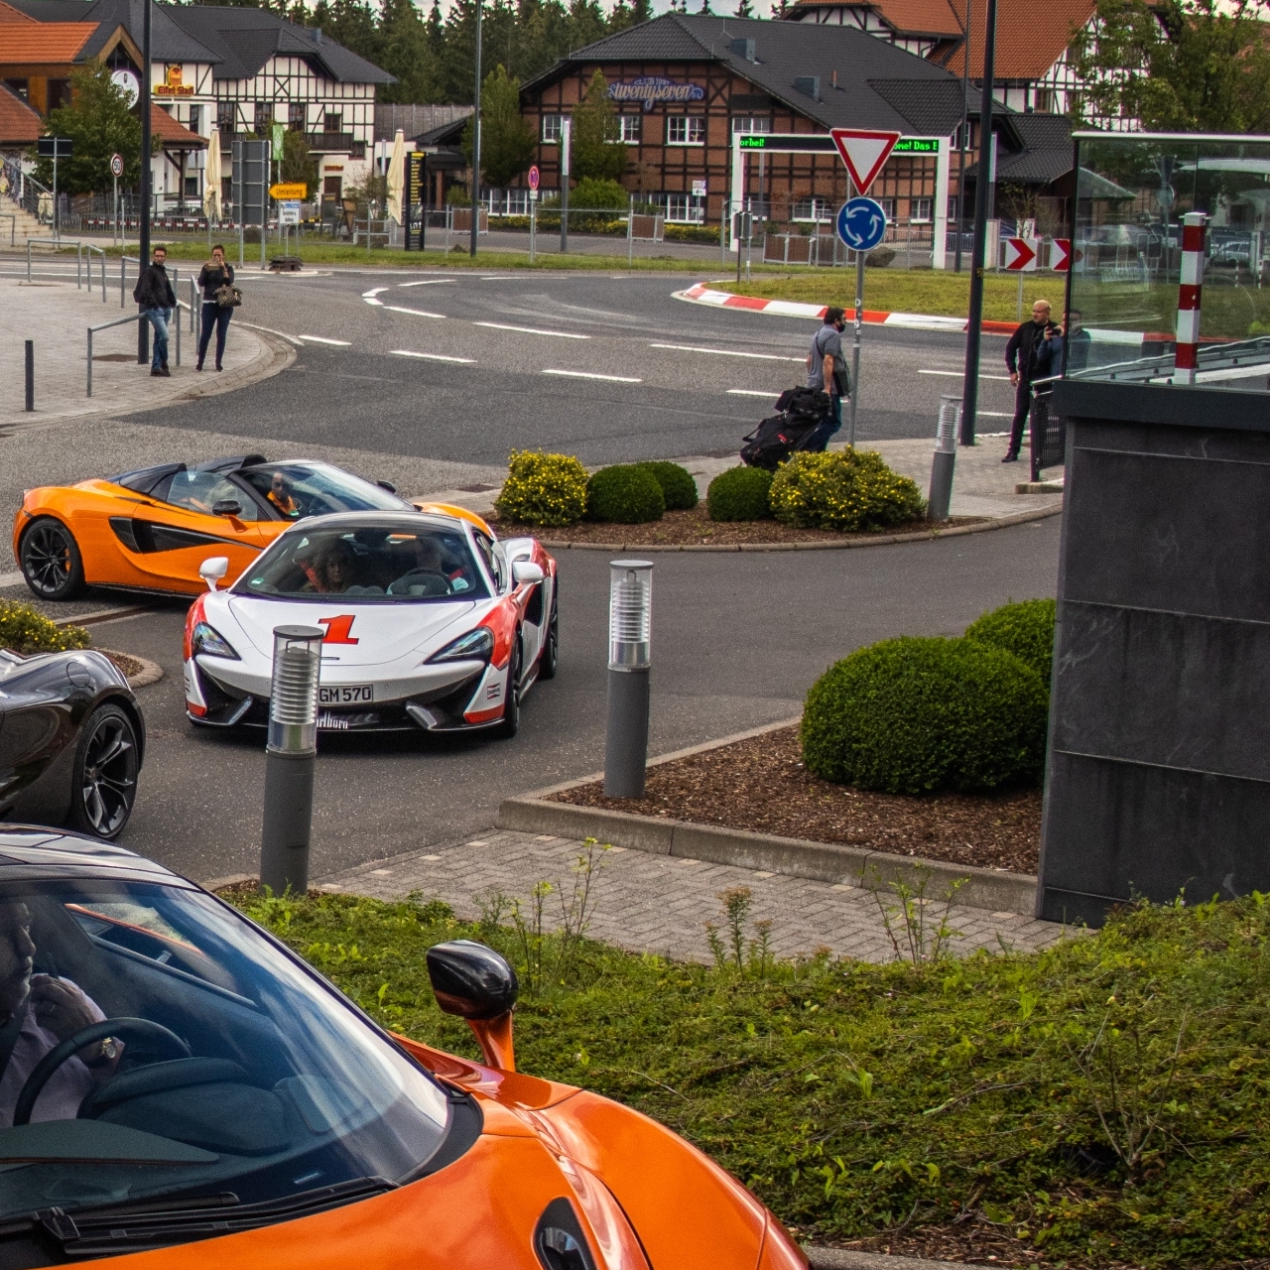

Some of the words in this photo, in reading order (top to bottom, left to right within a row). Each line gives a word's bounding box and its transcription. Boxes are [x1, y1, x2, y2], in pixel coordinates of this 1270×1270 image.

[914, 140, 930, 150] Das
[317, 614, 360, 645] 1
[319, 687, 340, 703] GM
[342, 686, 371, 702] 570
